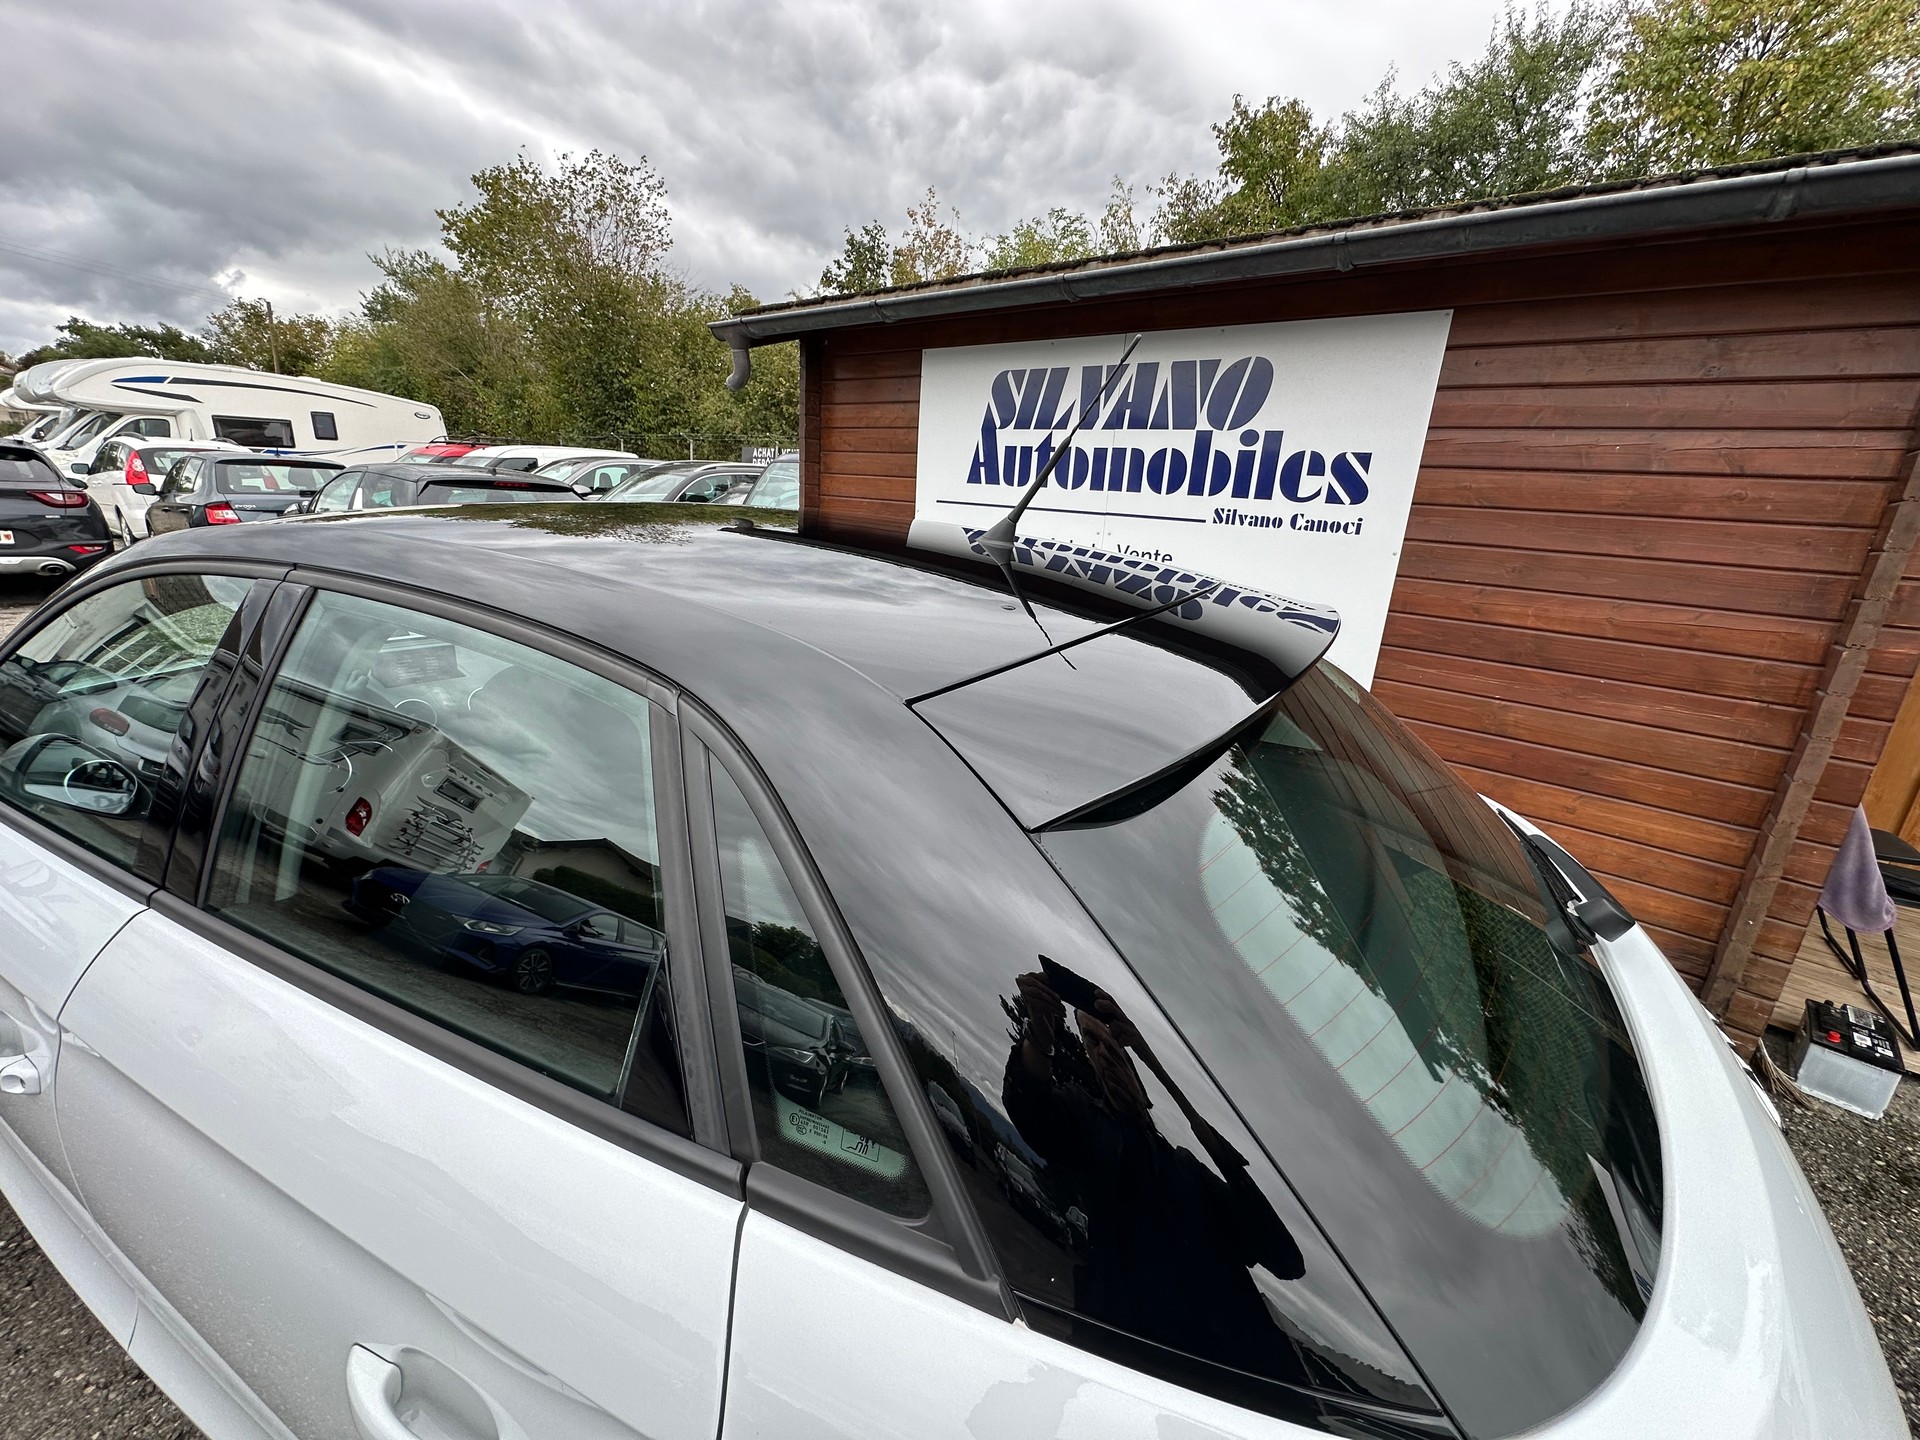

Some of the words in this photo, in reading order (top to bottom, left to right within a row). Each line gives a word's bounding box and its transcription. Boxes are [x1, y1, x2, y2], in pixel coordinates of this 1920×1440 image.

[991, 356, 1274, 431] SILVANO
[753, 447, 775, 458] ACHAT
[966, 402, 1373, 506] Automobiles
[1212, 507, 1283, 529] Silvano
[1289, 513, 1364, 536] Canoci
